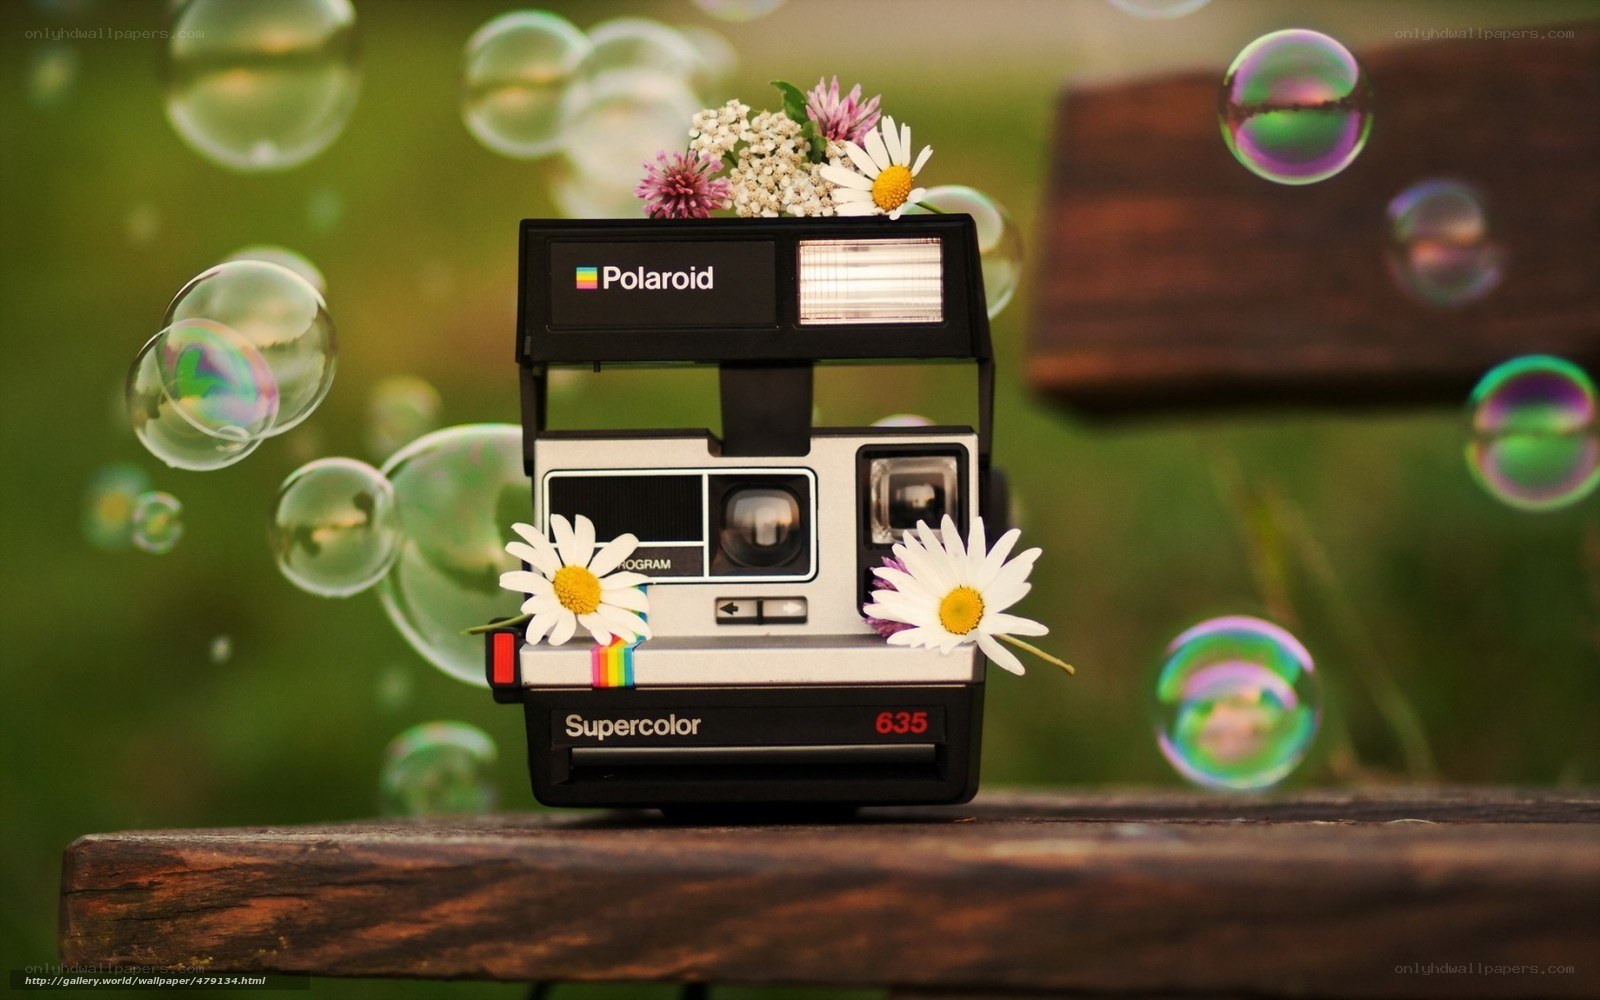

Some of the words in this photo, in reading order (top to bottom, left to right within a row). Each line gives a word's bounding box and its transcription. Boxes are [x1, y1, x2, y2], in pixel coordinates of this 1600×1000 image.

[602, 266, 714, 290] Polaroid
[616, 558, 671, 570] ROGRAM
[565, 714, 701, 741] Supercolor
[875, 712, 928, 733] 635
